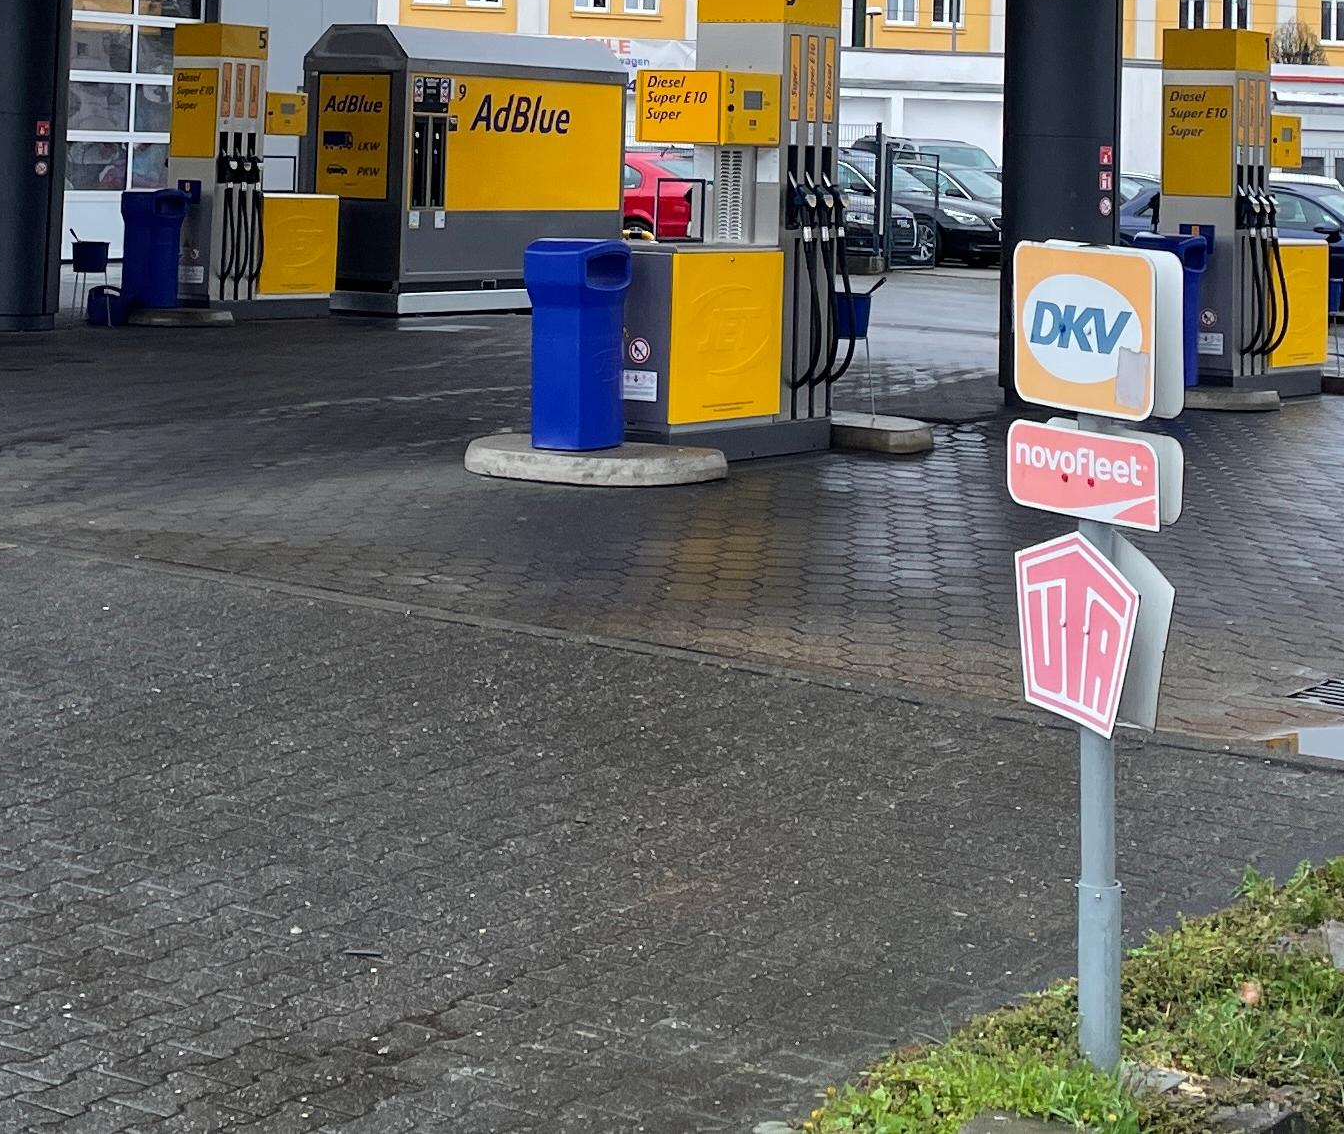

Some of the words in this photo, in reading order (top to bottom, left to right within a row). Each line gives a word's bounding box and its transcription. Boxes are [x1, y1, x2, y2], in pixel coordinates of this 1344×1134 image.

[259, 31, 267, 49] 5
[177, 72, 201, 83] Diesel
[648, 75, 686, 88] Diesel
[176, 86, 198, 97] Super
[459, 83, 466, 101] 9
[729, 78, 735, 94] 3
[646, 91, 682, 107] Super
[1169, 91, 1206, 102] Diesel
[175, 100, 197, 110] Super
[324, 95, 384, 115] AdBlue
[470, 93, 571, 135] AdBlue
[646, 108, 681, 123] Super
[1169, 108, 1203, 122] Super
[1168, 125, 1204, 139] Super
[357, 141, 381, 151] LKW
[357, 167, 381, 177] PKW
[1030, 300, 1132, 354] DKV
